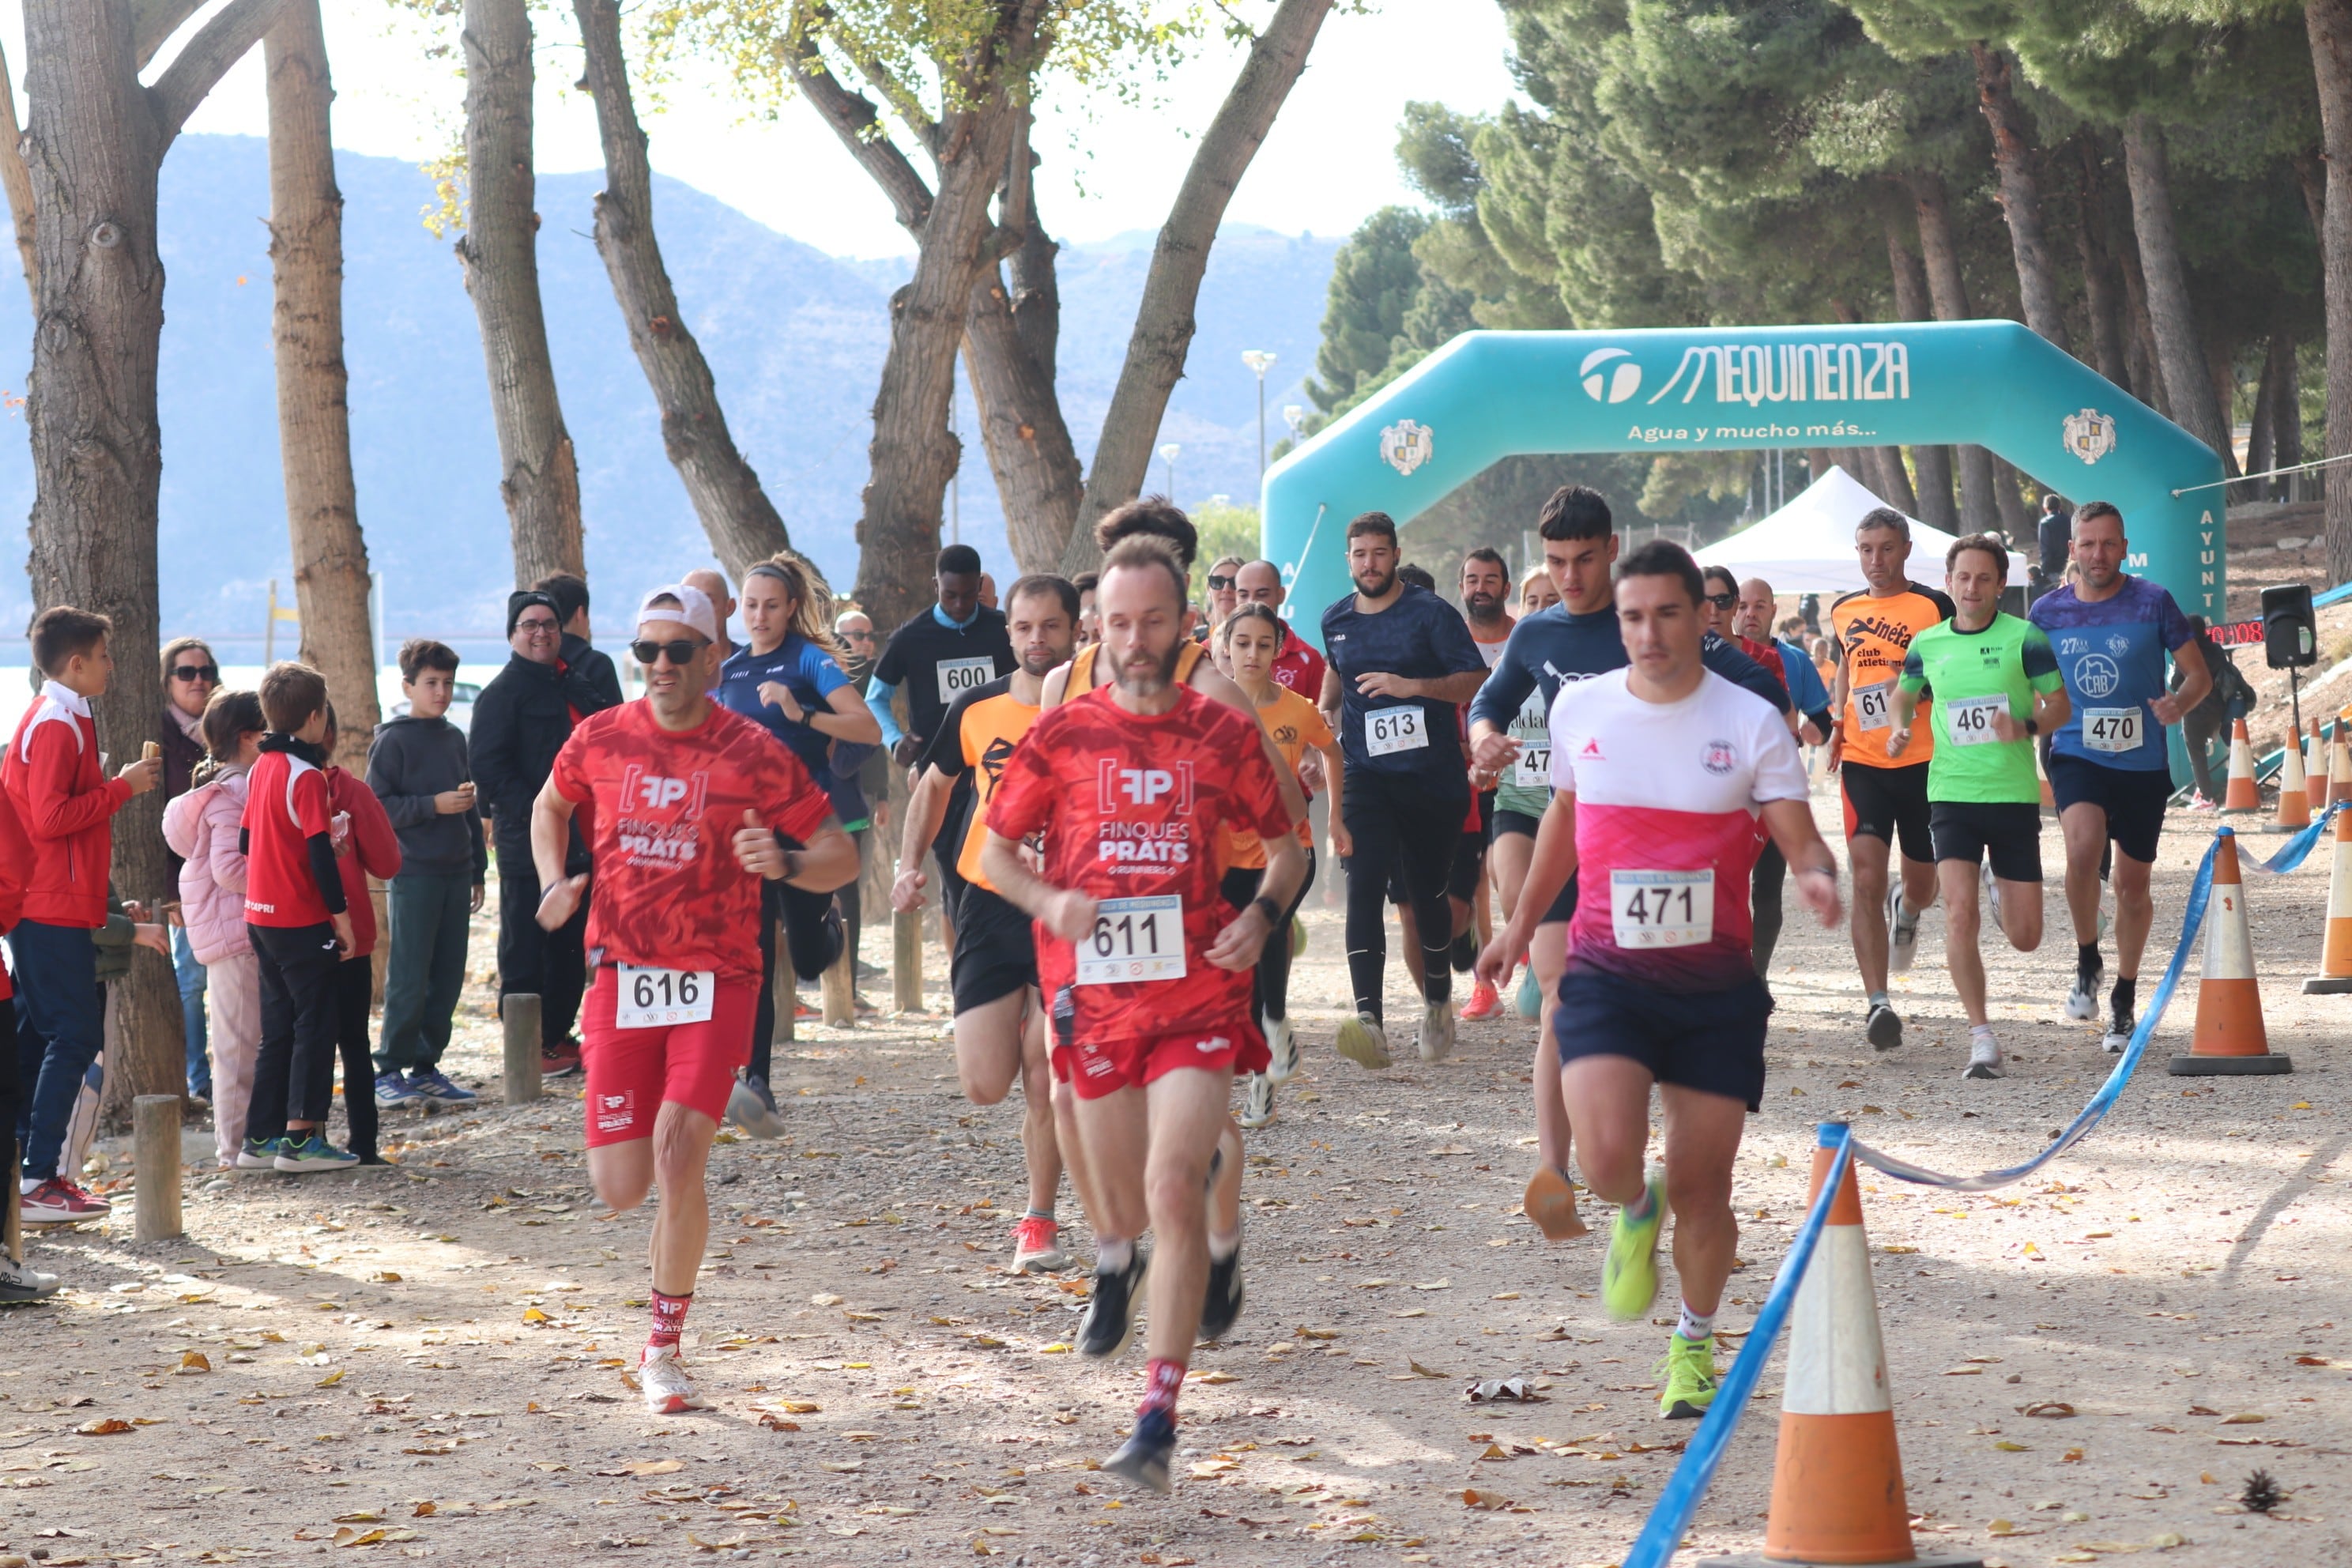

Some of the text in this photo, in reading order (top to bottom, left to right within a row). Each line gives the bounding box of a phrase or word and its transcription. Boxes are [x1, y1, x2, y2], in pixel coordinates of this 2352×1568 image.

[1646, 342, 1909, 407] MEQUINENZA
[1627, 420, 1877, 443] Agua y mucho más...
[2205, 621, 2263, 645] 0:08
[1857, 648, 1880, 657] club
[948, 666, 986, 689] 600
[2086, 674, 2109, 693] CAB
[1863, 691, 1888, 716] 61
[1374, 714, 1415, 740] 613
[1958, 705, 1999, 731] 467
[2092, 718, 2133, 739] 470
[618, 818, 699, 840] FINQUES
[1099, 821, 1189, 841] FINQUES
[619, 834, 697, 861] PRATS
[1099, 840, 1189, 863] PRATS
[1626, 886, 1691, 925] 471
[1094, 913, 1158, 957] 611
[634, 971, 699, 1008] 616
